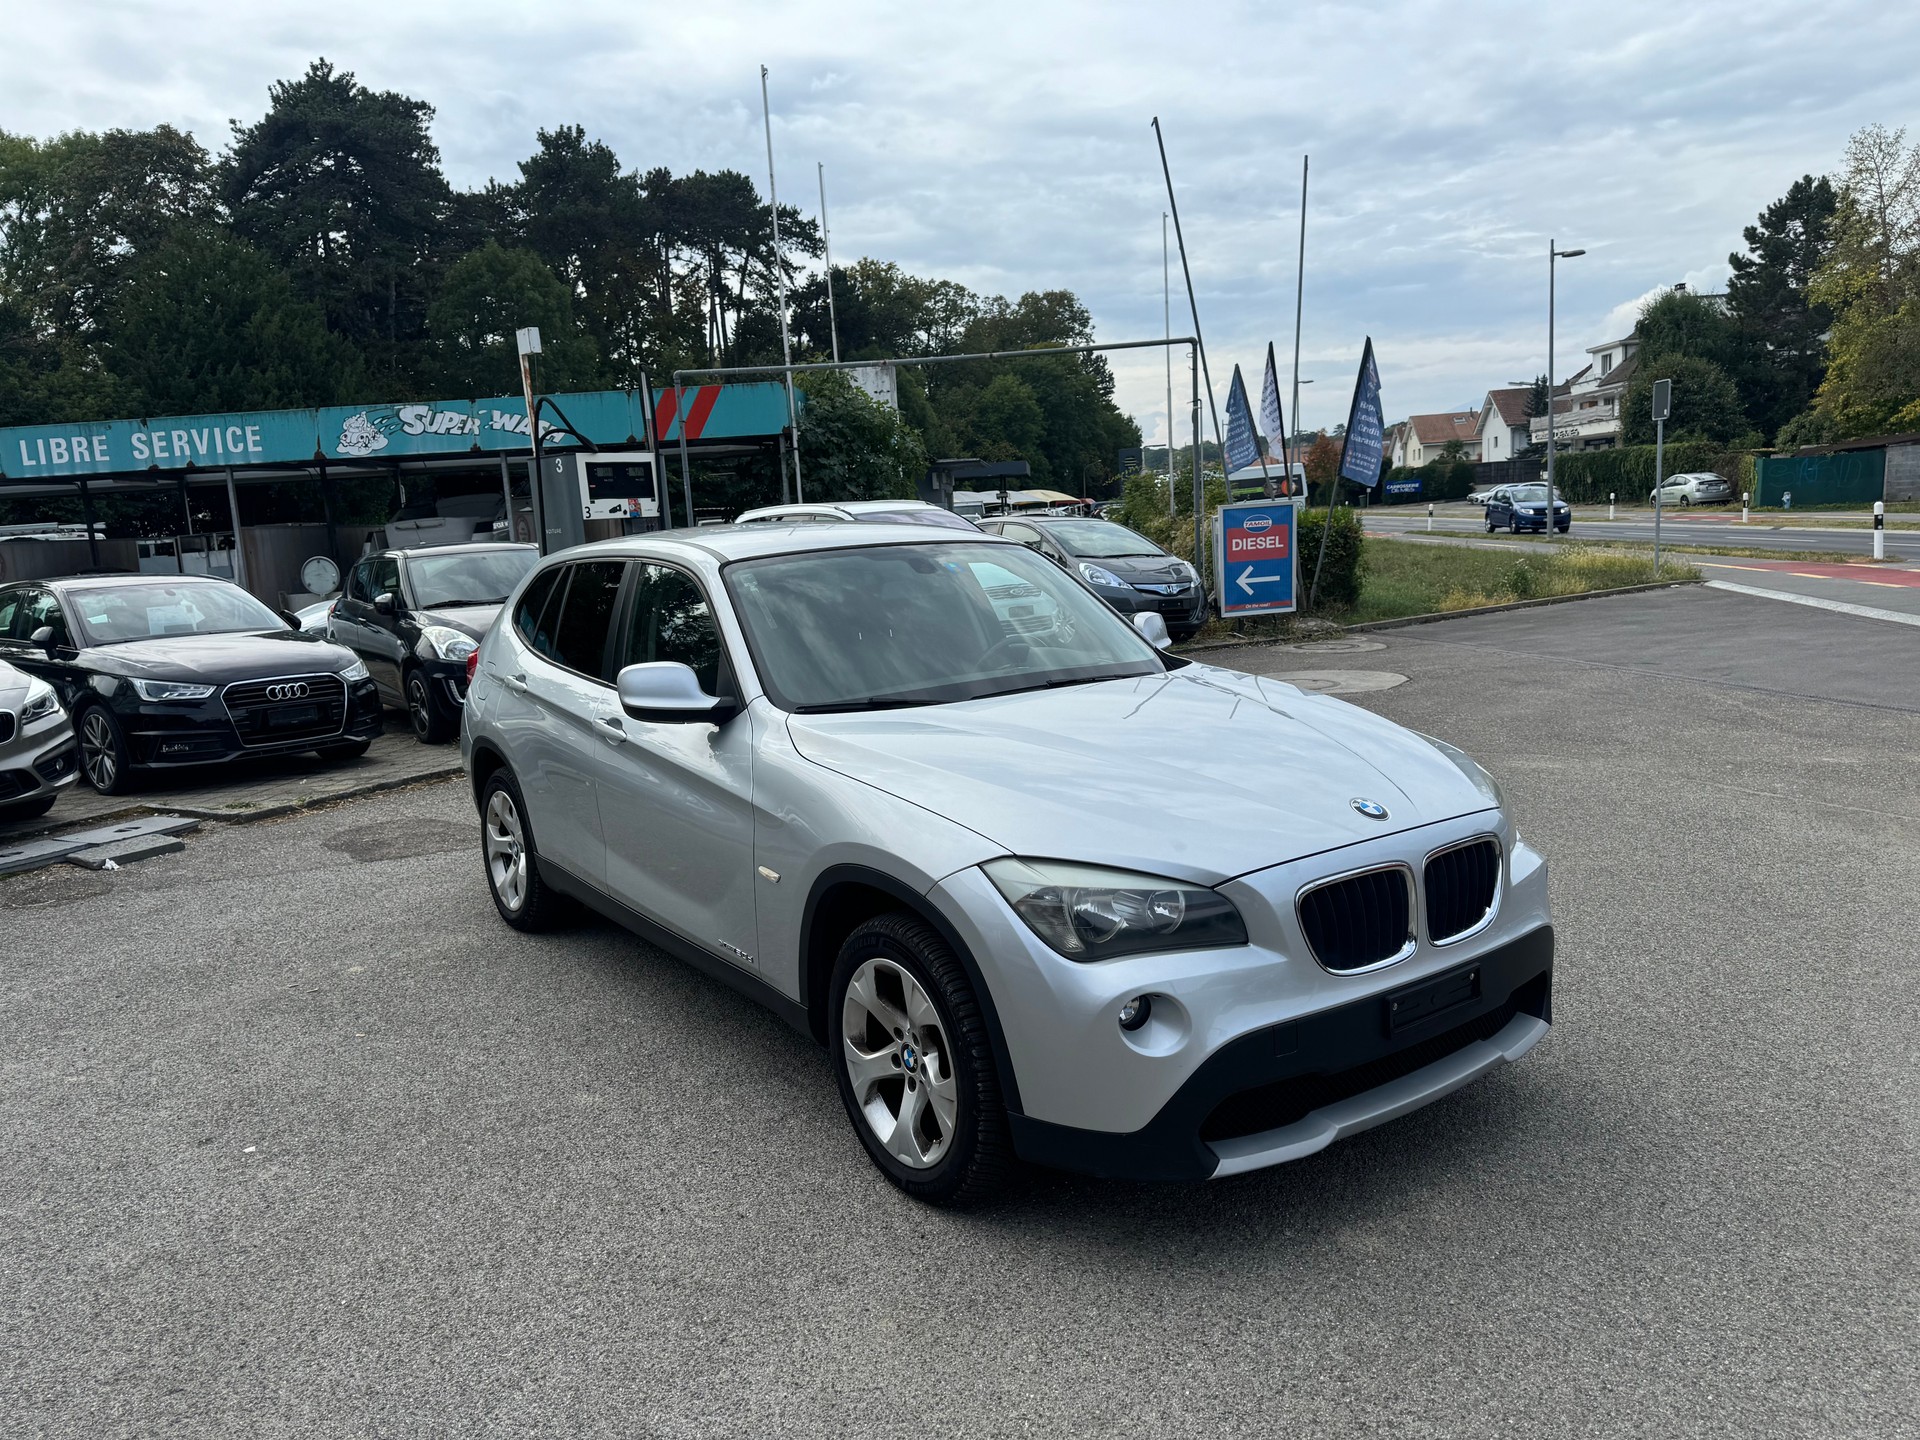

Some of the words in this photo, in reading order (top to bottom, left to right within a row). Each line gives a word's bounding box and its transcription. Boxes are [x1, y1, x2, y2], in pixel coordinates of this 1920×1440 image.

[398, 405, 481, 436] SUPER
[19, 435, 110, 466] LIBRE
[130, 425, 263, 460] SERVICE
[555, 457, 563, 473] 3
[584, 506, 592, 519] 3
[1231, 535, 1284, 551] DIESEL
